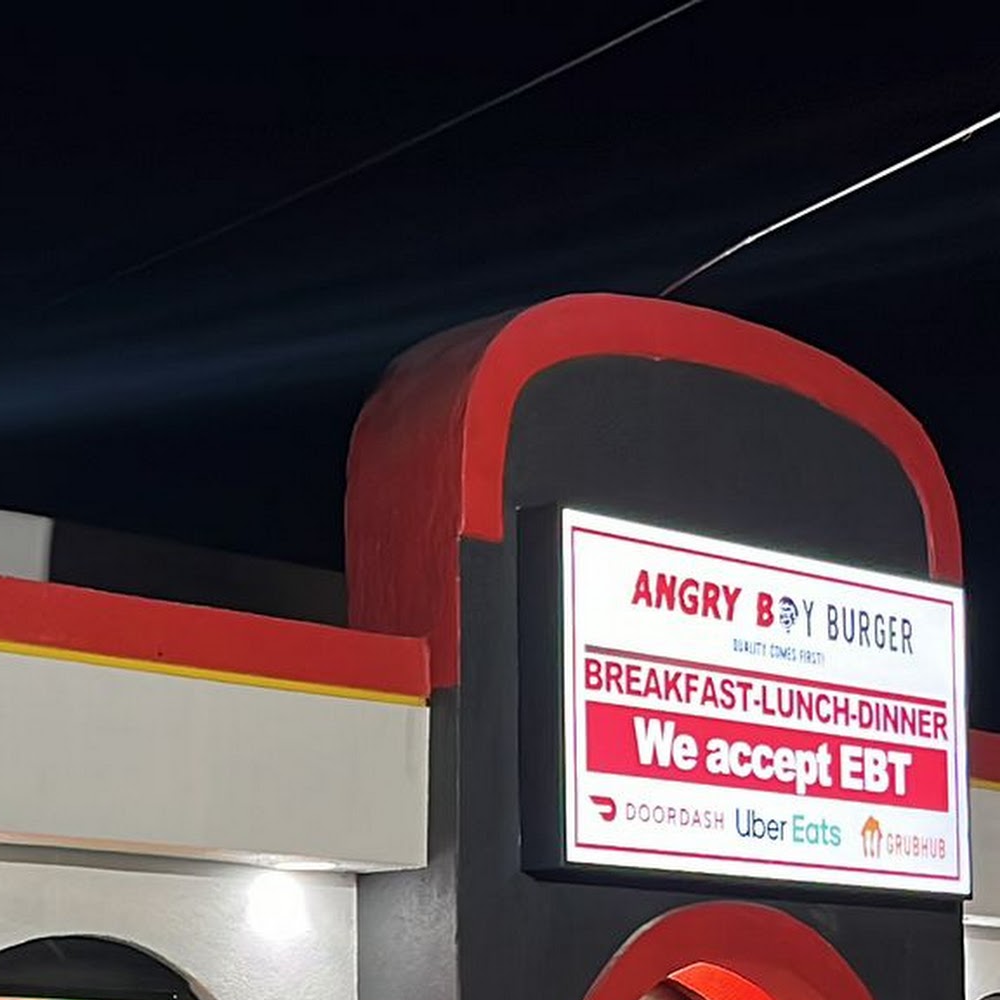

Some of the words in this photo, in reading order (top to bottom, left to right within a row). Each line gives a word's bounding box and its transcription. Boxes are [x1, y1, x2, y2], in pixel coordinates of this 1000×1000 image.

[632, 570, 742, 622] ANGRY
[827, 603, 914, 655] BURGER
[584, 658, 948, 741] BREAKFAST-LUNCH-DINNER
[633, 716, 698, 770] We
[705, 736, 833, 795] accept
[840, 743, 913, 796] EBT
[626, 802, 725, 831] DOORDASH
[735, 808, 787, 842] Uber
[792, 815, 842, 847] Eats
[886, 832, 946, 860] GRUBHUB
